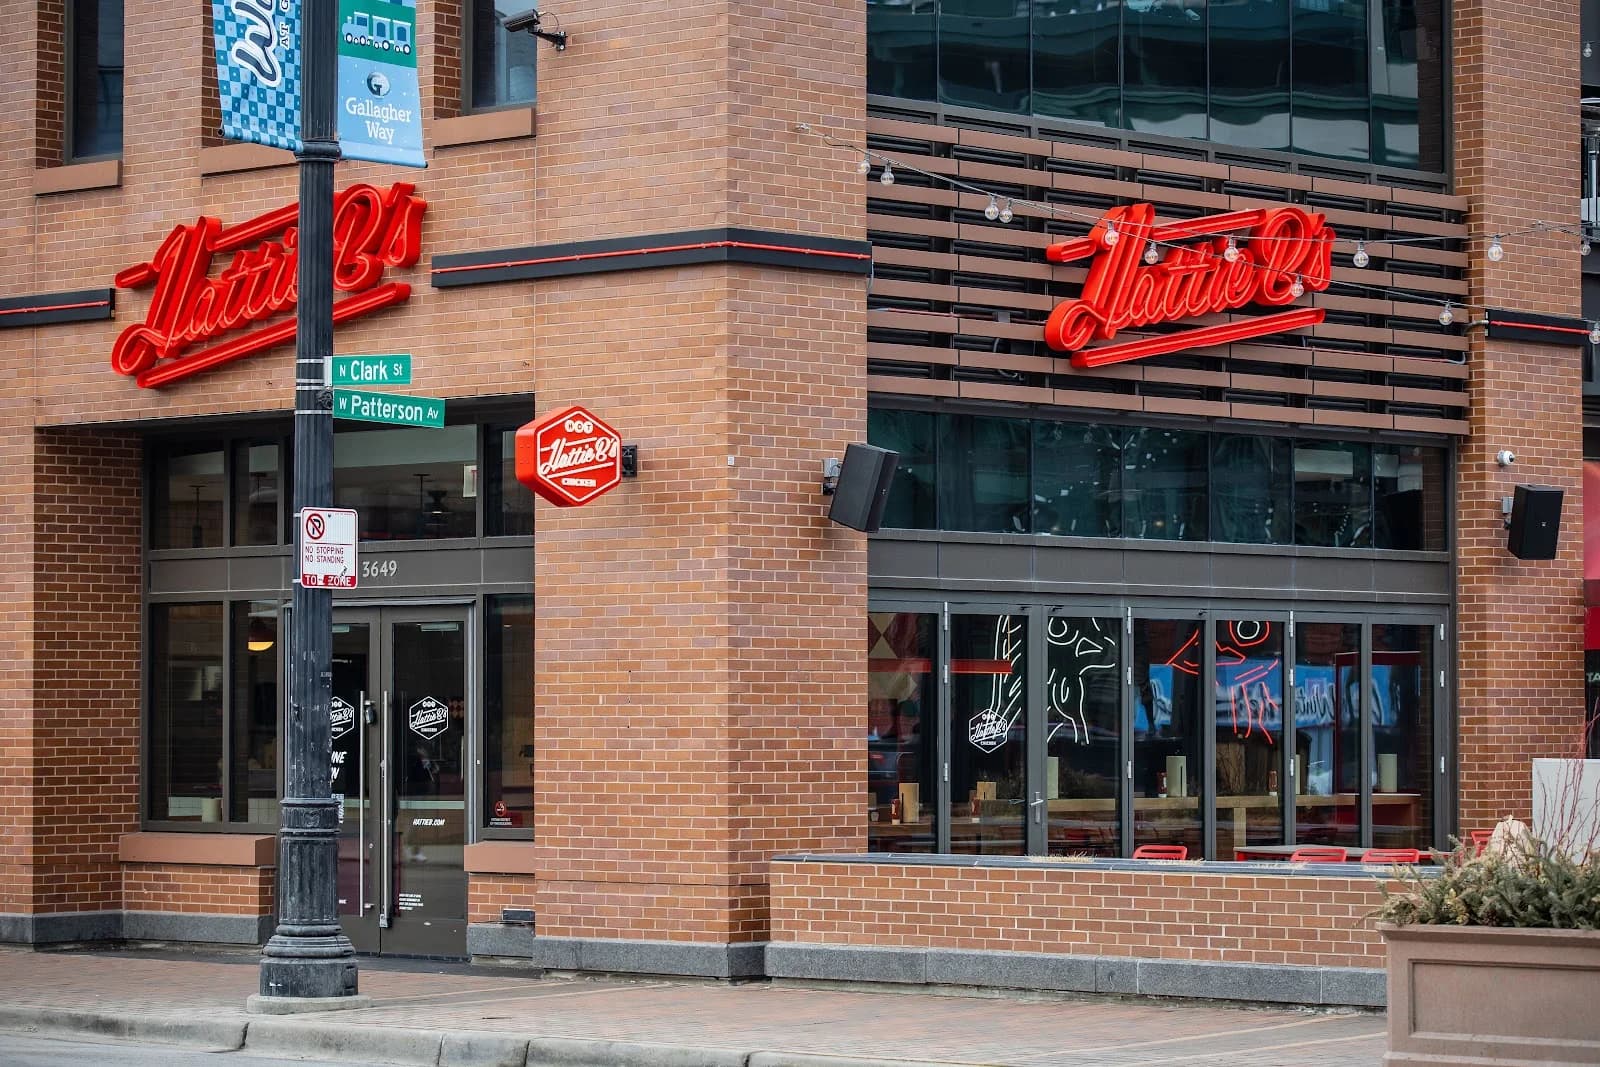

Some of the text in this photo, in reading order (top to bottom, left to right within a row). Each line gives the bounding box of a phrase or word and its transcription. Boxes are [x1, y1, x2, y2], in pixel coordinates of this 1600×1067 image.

[280, 22, 290, 50] AT
[345, 97, 412, 123] Gallagher
[365, 120, 395, 145] Way
[339, 360, 403, 380] N Clark St
[339, 395, 439, 422] W Patterson Av
[565, 420, 593, 434] HOT
[305, 546, 344, 555] NO STOPPING
[305, 555, 344, 564] NO STANDING
[362, 560, 398, 578] 3649
[327, 576, 352, 587] ZONE
